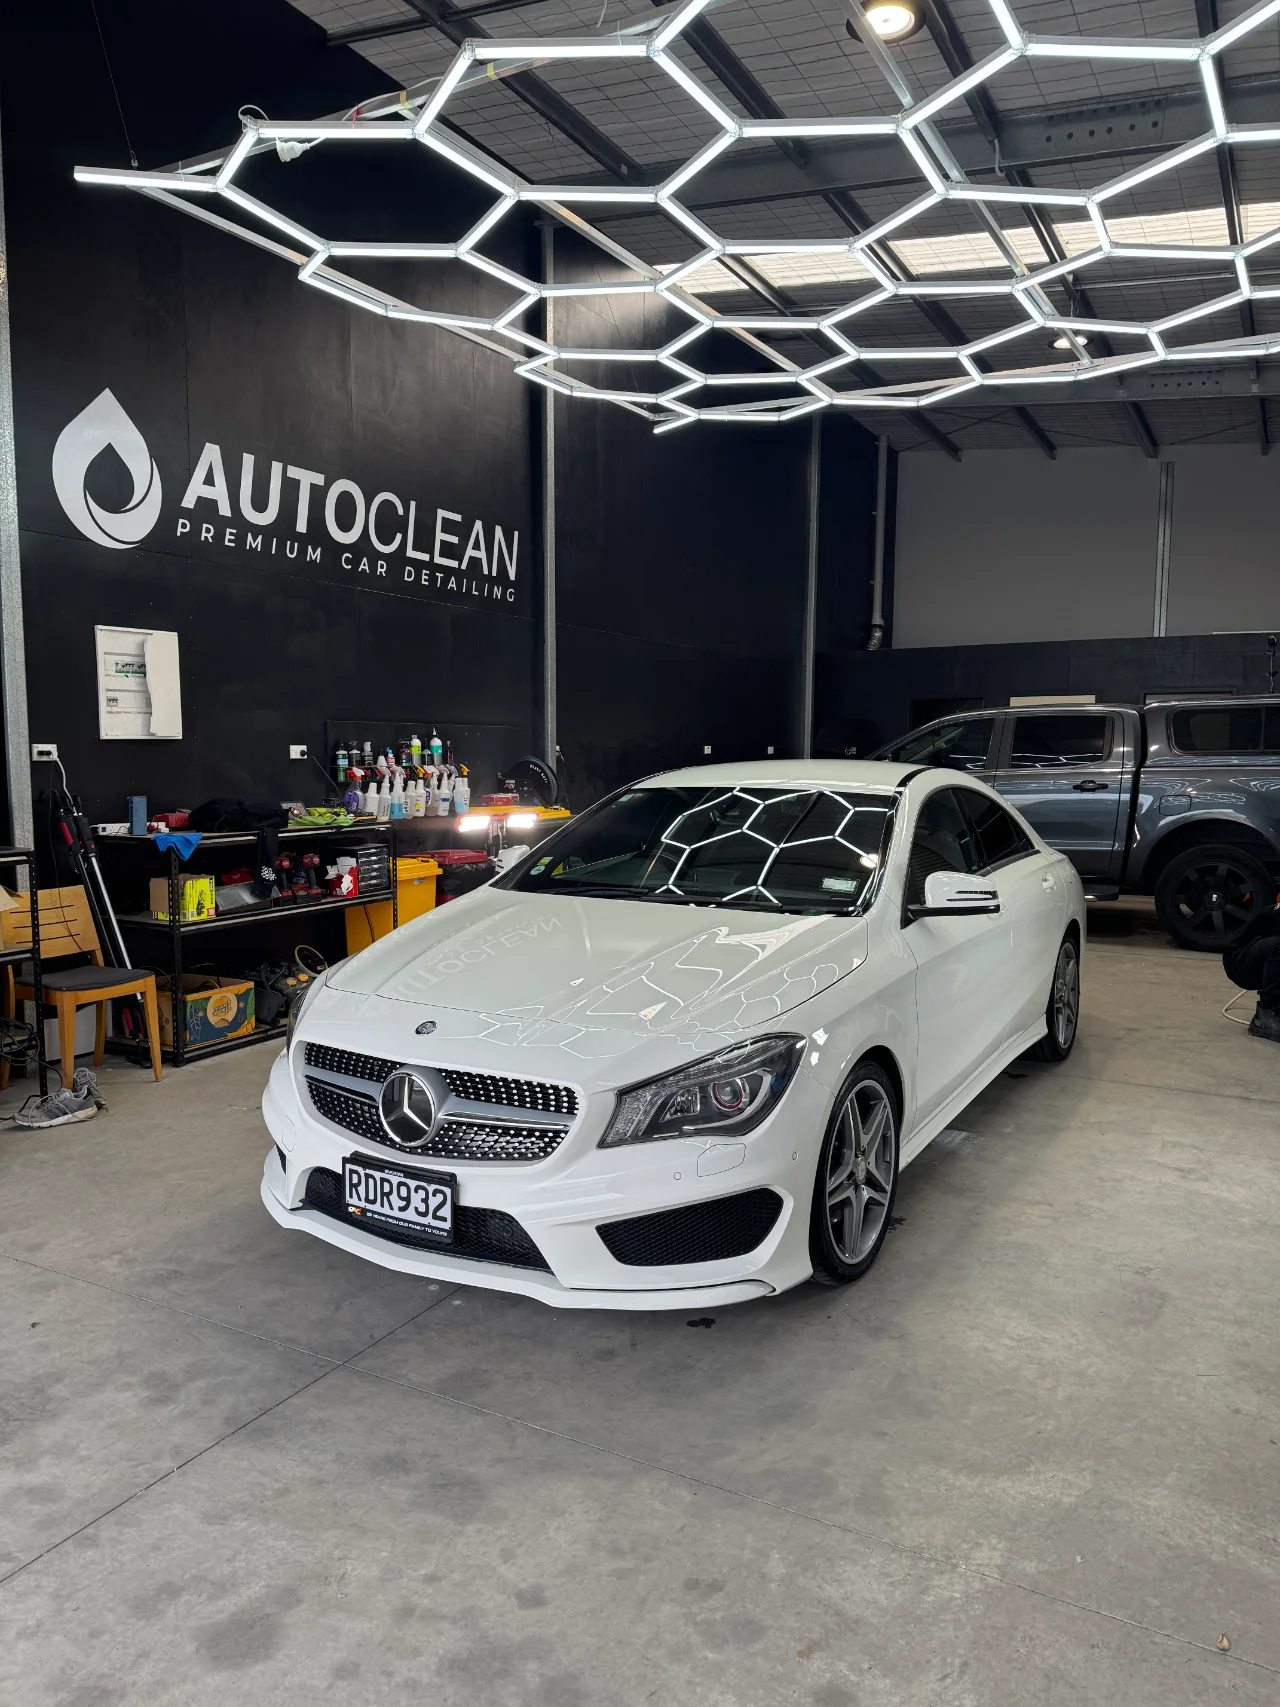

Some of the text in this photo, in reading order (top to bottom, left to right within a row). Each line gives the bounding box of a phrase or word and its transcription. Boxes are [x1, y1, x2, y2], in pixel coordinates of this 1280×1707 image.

[180, 441, 519, 581] AUTOCLEAN
[176, 518, 516, 602] PREMIUM CAR DETAILING
[348, 1167, 448, 1223] RDR932
[408, 1223, 425, 1231] FAMILY
[432, 1229, 448, 1237] YOURS
